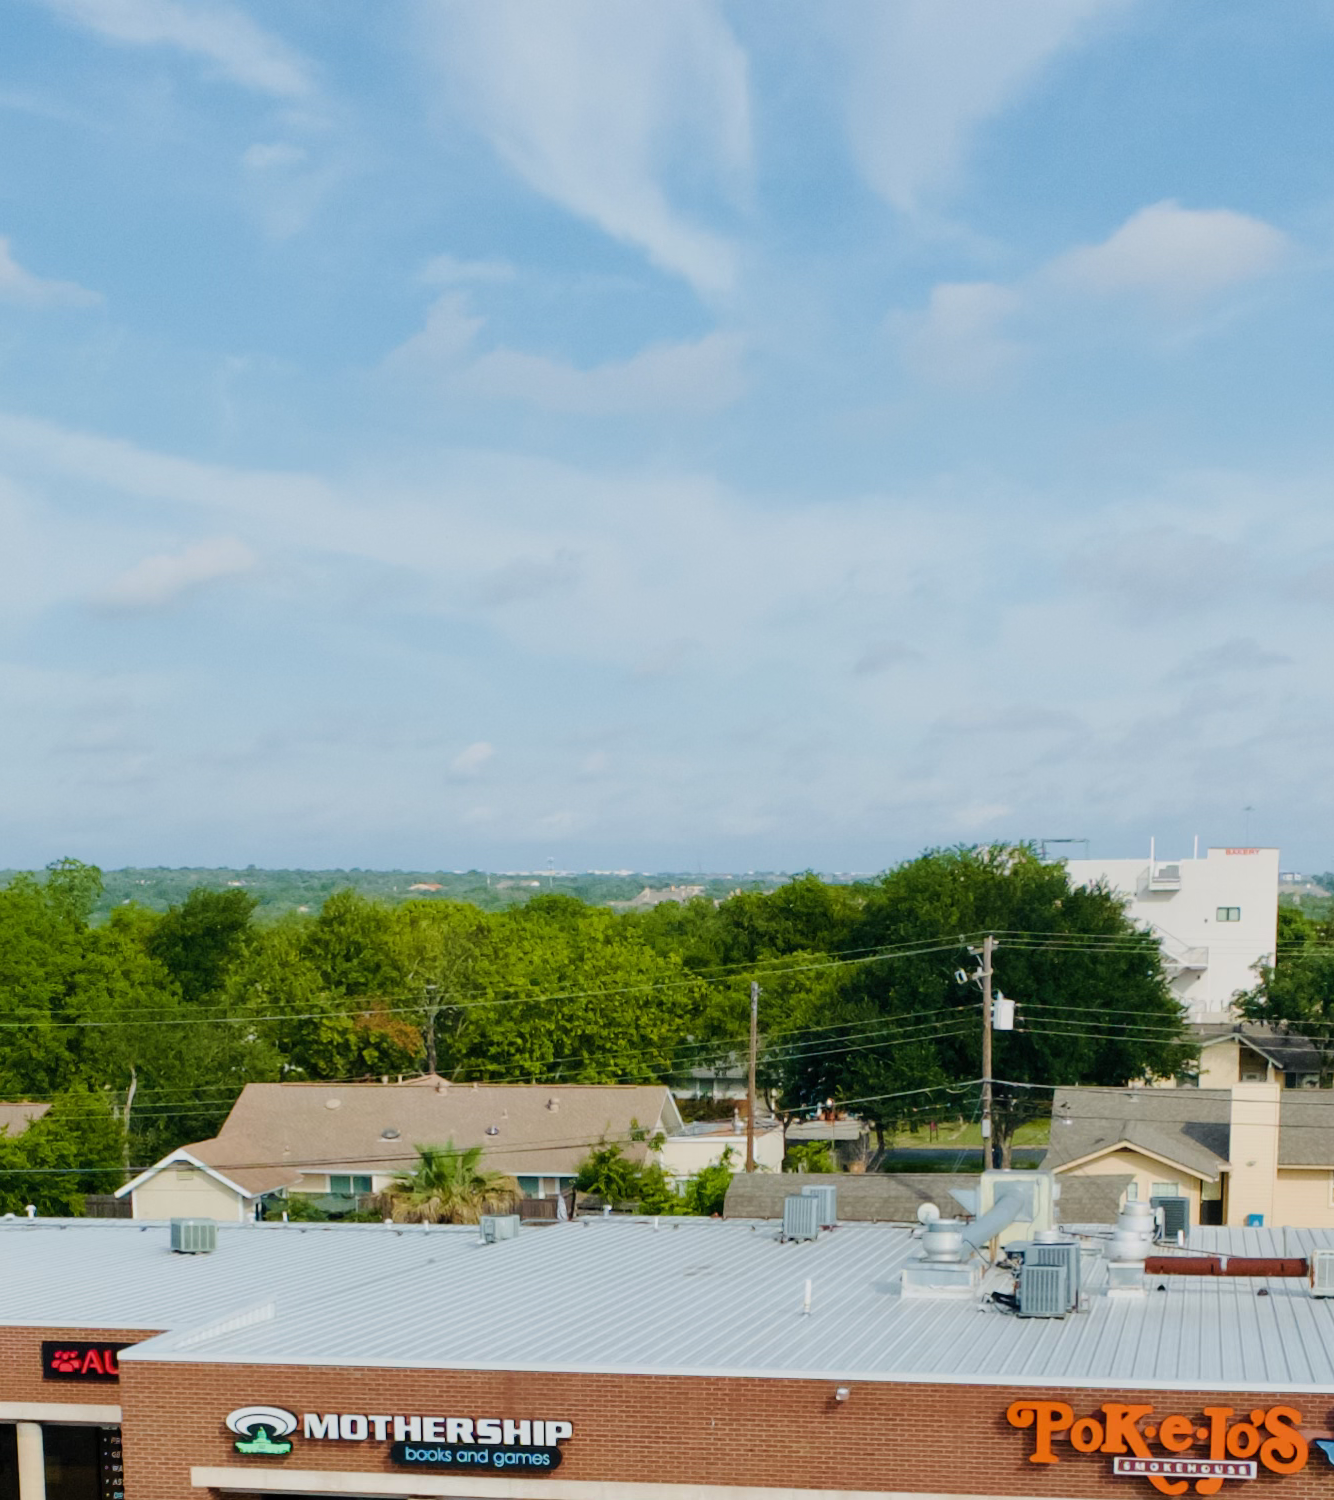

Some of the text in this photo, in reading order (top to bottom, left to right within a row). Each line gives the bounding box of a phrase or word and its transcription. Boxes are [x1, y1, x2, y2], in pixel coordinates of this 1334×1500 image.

[303, 1413, 573, 1447] MOTHERSHIP
[405, 1446, 551, 1468] books and games
[1122, 1461, 1249, 1476] SMOKEHOUSE
